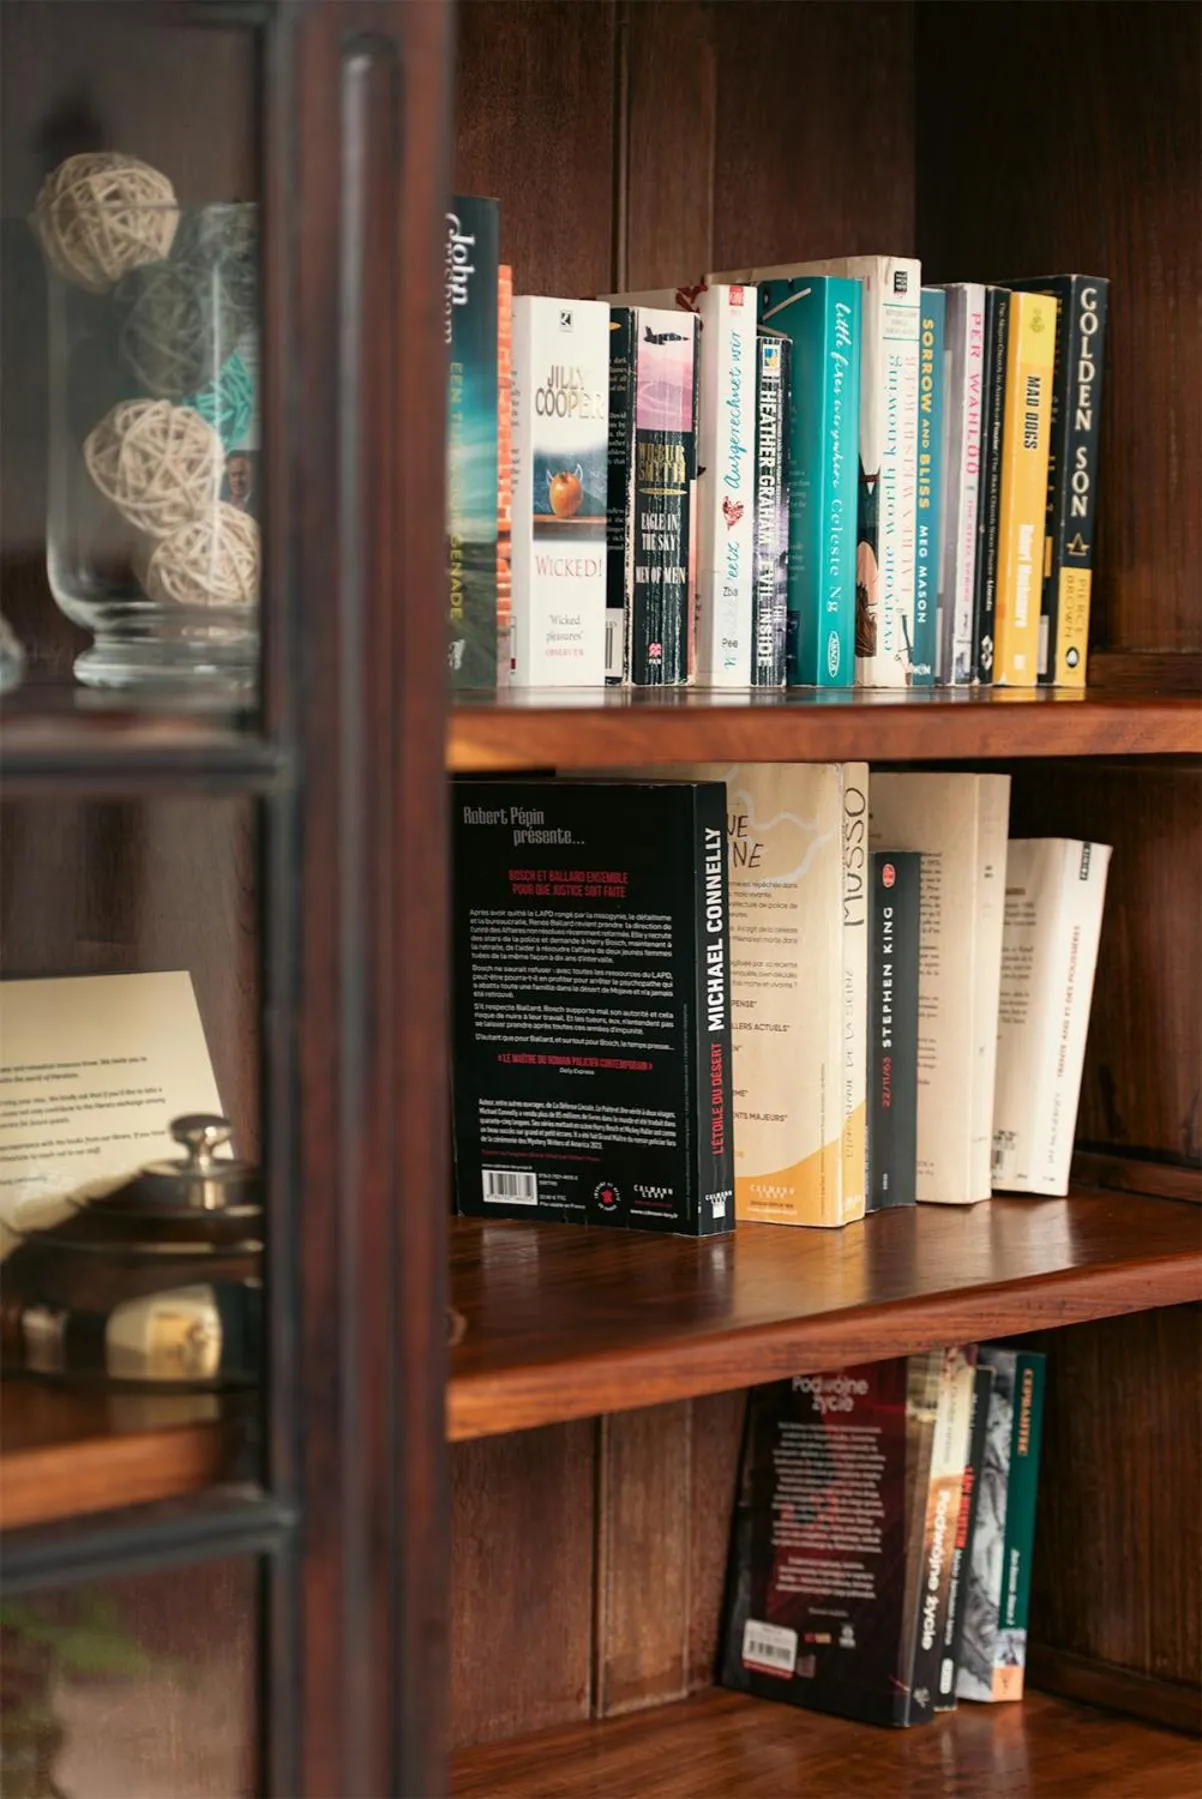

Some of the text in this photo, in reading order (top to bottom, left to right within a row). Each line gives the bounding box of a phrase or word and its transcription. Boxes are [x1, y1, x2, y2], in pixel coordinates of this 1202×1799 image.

[448, 230, 476, 306] John
[835, 302, 853, 348] little
[535, 386, 605, 420] COOPER
[546, 364, 585, 391] JILLY
[882, 353, 903, 457] knowing
[918, 318, 936, 509] SORROW AND BLISS
[964, 312, 983, 476] PER WAHLÖÖ
[1023, 376, 1041, 449] MAD DOGS
[1071, 287, 1099, 517] GOLDEN SON
[757, 390, 778, 545] HEATHER GRAHAM
[882, 465, 898, 534] worth
[641, 512, 665, 531] EAGLE
[666, 513, 680, 531] IN
[658, 533, 676, 550] SKY
[825, 499, 844, 614] Celeste Ng
[449, 533, 465, 621] GENADE
[635, 566, 687, 584] MEN OF MEN
[882, 546, 895, 652] everyone
[916, 525, 929, 624] MEG MASON
[756, 607, 775, 667] INSIDE
[463, 805, 545, 828] Robert Pépin
[513, 828, 585, 847] présente...
[843, 787, 866, 927] MUSSO
[704, 827, 725, 1031] MICHAEL CONNELLY
[881, 906, 894, 1048] STEPHEN KING
[709, 1042, 725, 1155] L'ÉTOILE DU DÉSERT
[927, 1488, 951, 1592] Podwójne
[921, 1594, 940, 1651] życie
